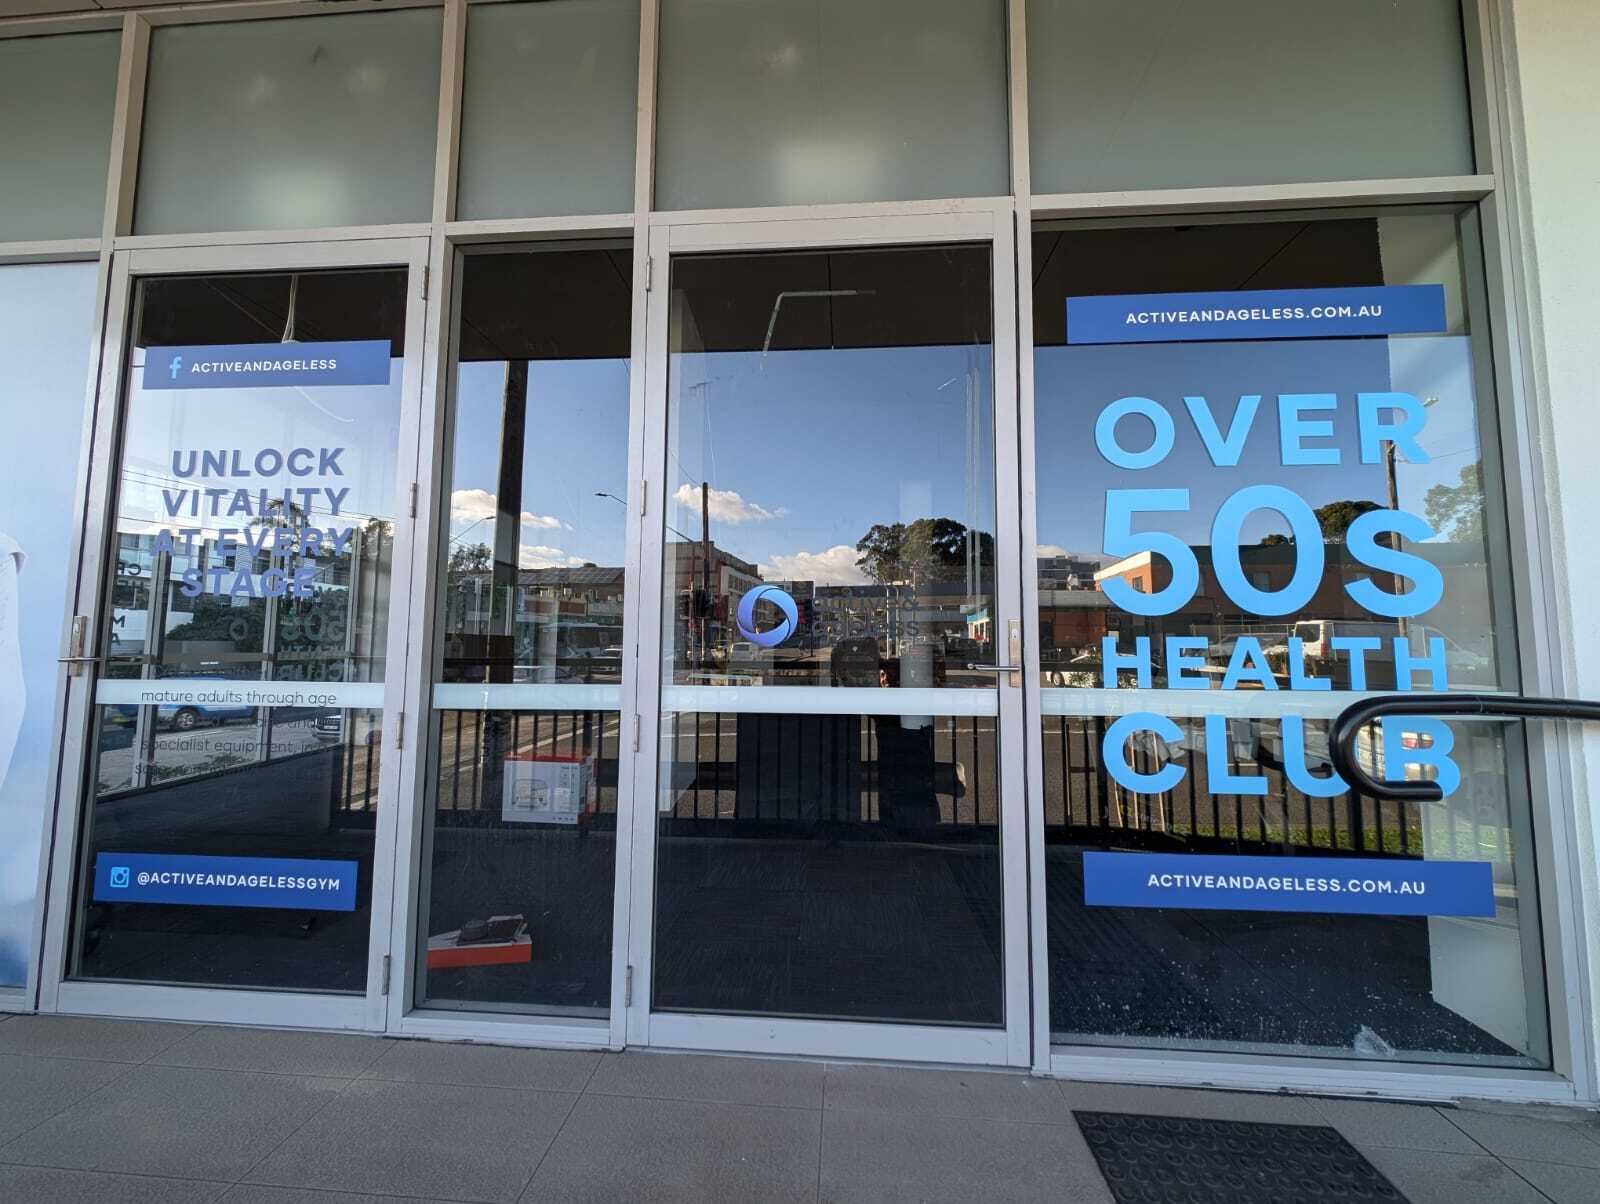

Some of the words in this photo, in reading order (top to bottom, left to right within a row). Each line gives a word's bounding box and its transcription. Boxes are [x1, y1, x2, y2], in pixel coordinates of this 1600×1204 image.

[1126, 305, 1383, 325] ACTIVEANDAGELESS.COM.AU
[191, 358, 338, 373] ACTIVEANDAGELESS
[1094, 391, 1432, 470] OVER
[171, 447, 346, 478] UNLOCK
[162, 487, 350, 518] VITALITY
[149, 527, 202, 557] AT
[216, 527, 354, 557] EVERY
[179, 566, 316, 599] STAGE
[1102, 636, 1449, 692] HEALTH
[140, 690, 193, 703] mature
[197, 689, 243, 704] adults
[246, 690, 305, 706] through
[307, 694, 338, 708] age
[1103, 711, 1461, 798] CLUB
[137, 872, 340, 891] @ACTIVEANDAGELESSGYM
[1147, 873, 1426, 896] ACTIVEANDAGELESS.COM.AU
